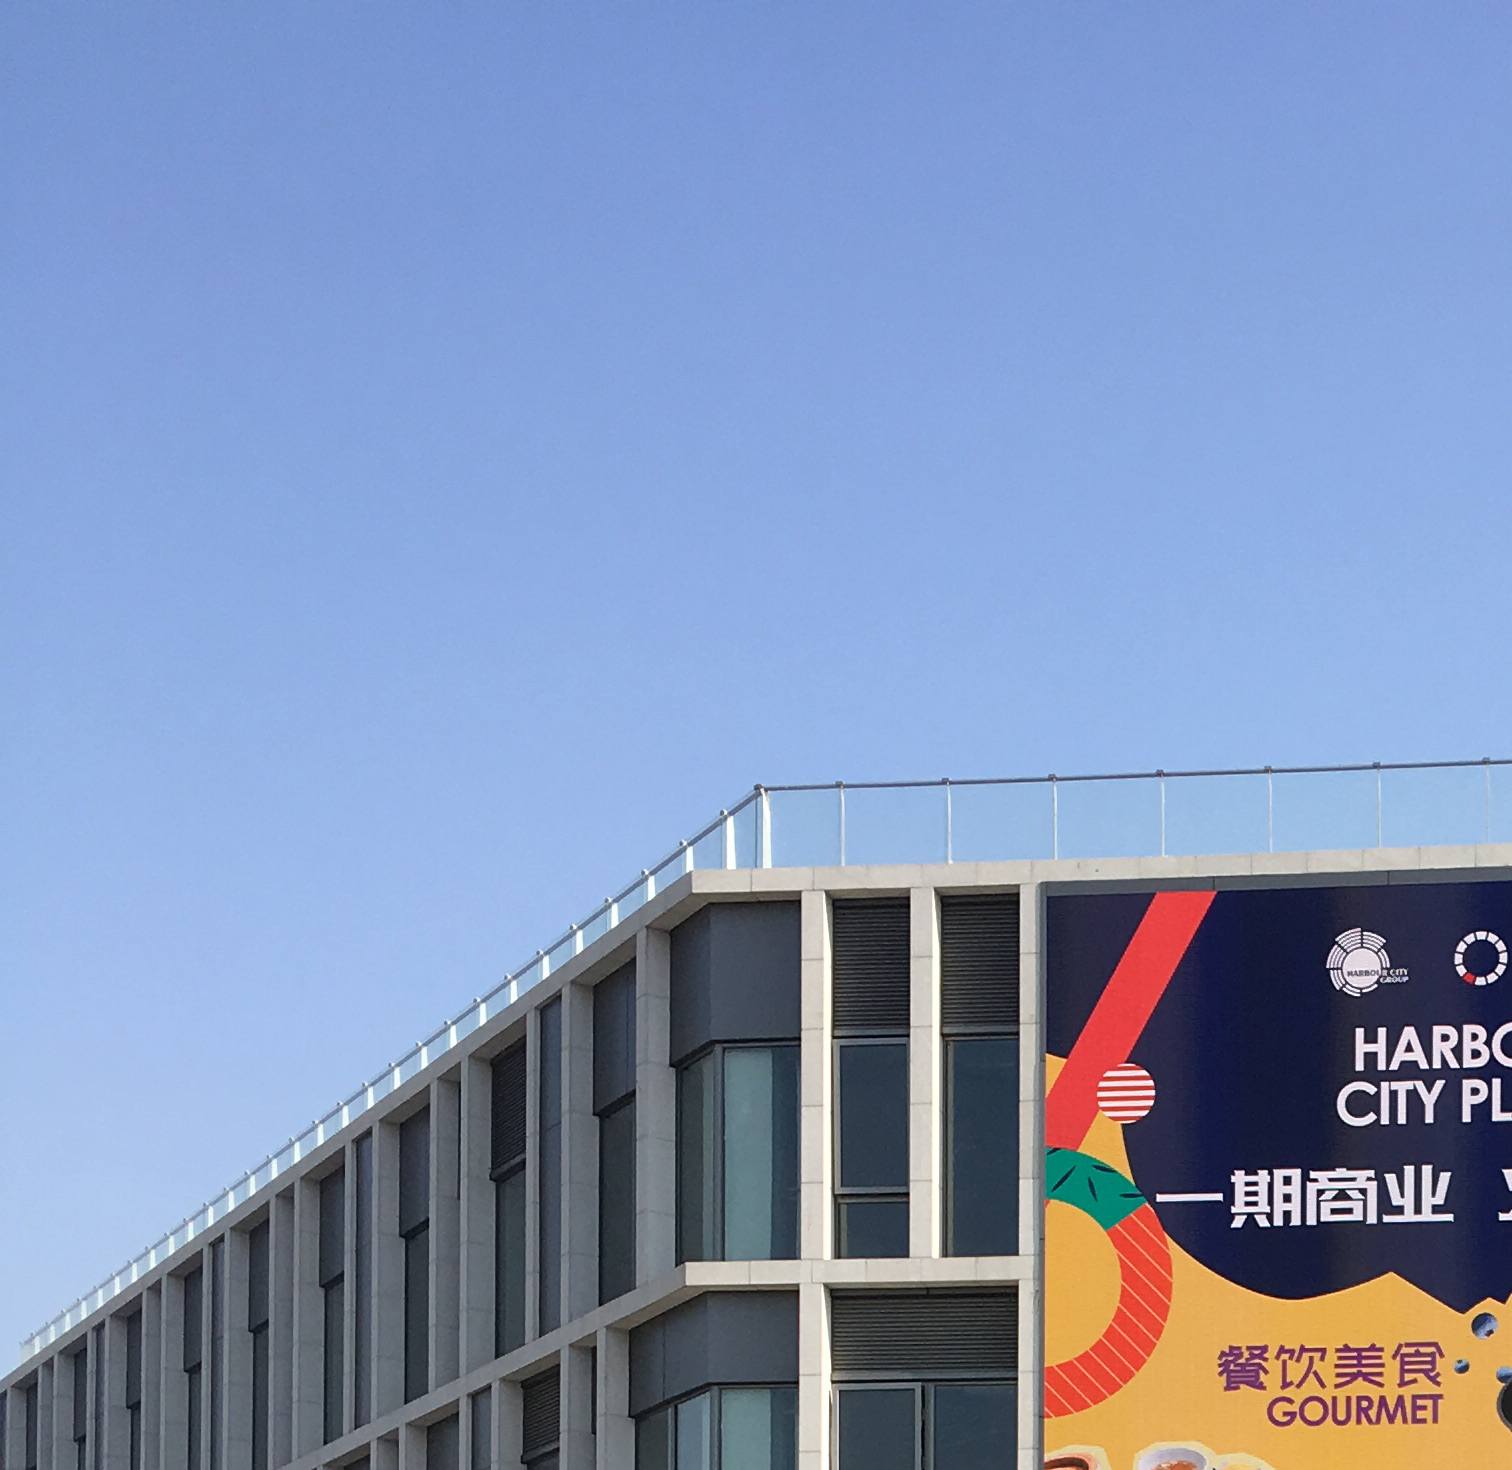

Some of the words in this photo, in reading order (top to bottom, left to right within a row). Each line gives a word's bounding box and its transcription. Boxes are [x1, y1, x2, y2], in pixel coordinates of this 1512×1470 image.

[1336, 1079, 1446, 1127] CITY
[1155, 1164, 1455, 1228] 一期商业
[1217, 1341, 1446, 1392] 餐饮美食
[1266, 1393, 1445, 1428] GOURMET
